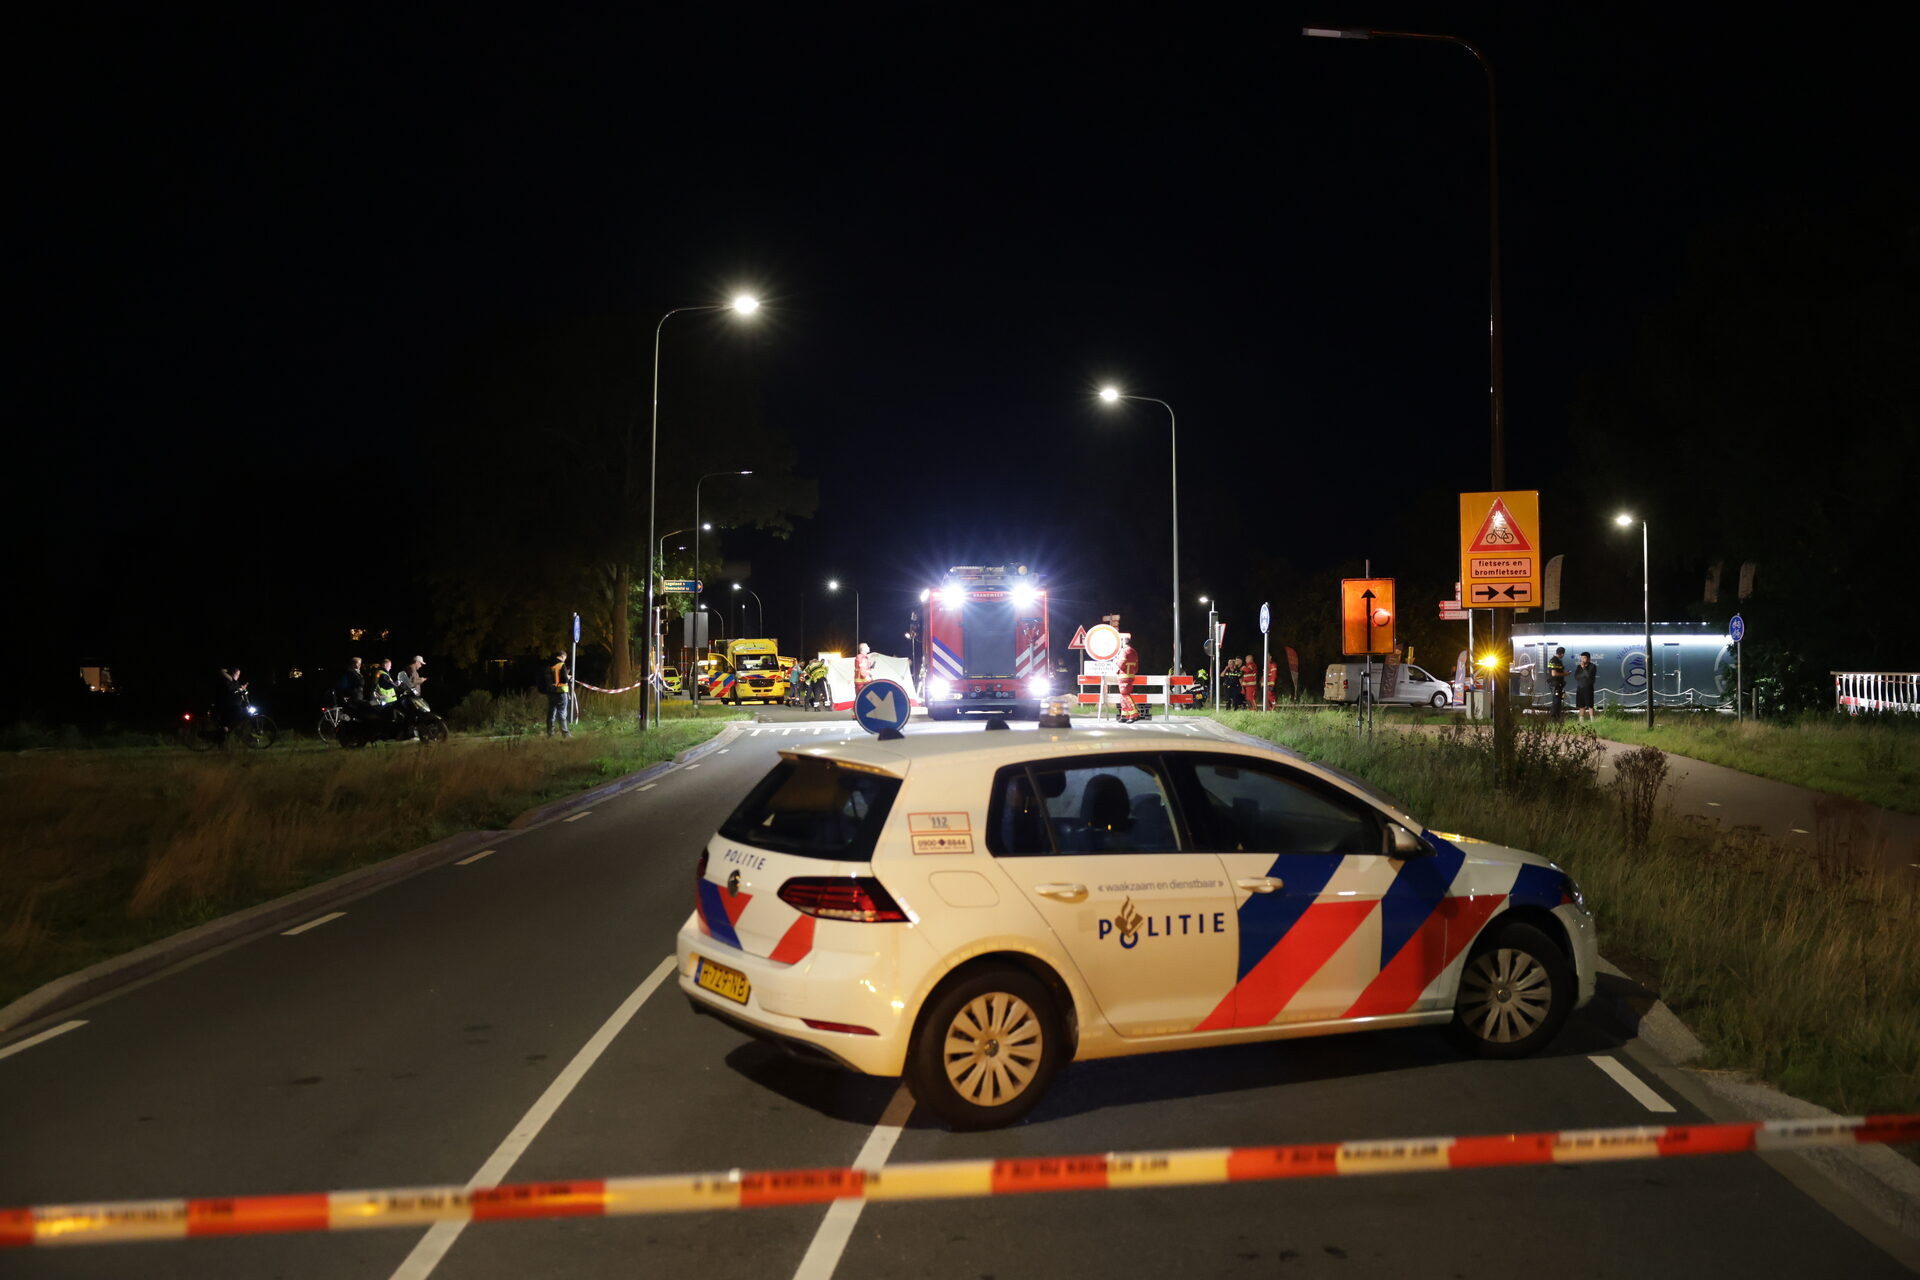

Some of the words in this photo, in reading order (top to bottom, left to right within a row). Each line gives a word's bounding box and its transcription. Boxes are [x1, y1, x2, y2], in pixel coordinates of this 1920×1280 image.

[1474, 568, 1527, 576] bromfietsers
[931, 816, 948, 827] 112
[724, 848, 767, 871] POLITIE
[1105, 881, 1155, 892] waakzaam
[1156, 882, 1168, 890] en
[1169, 879, 1217, 889] dienstbaar
[1098, 912, 1225, 949] POLITIE
